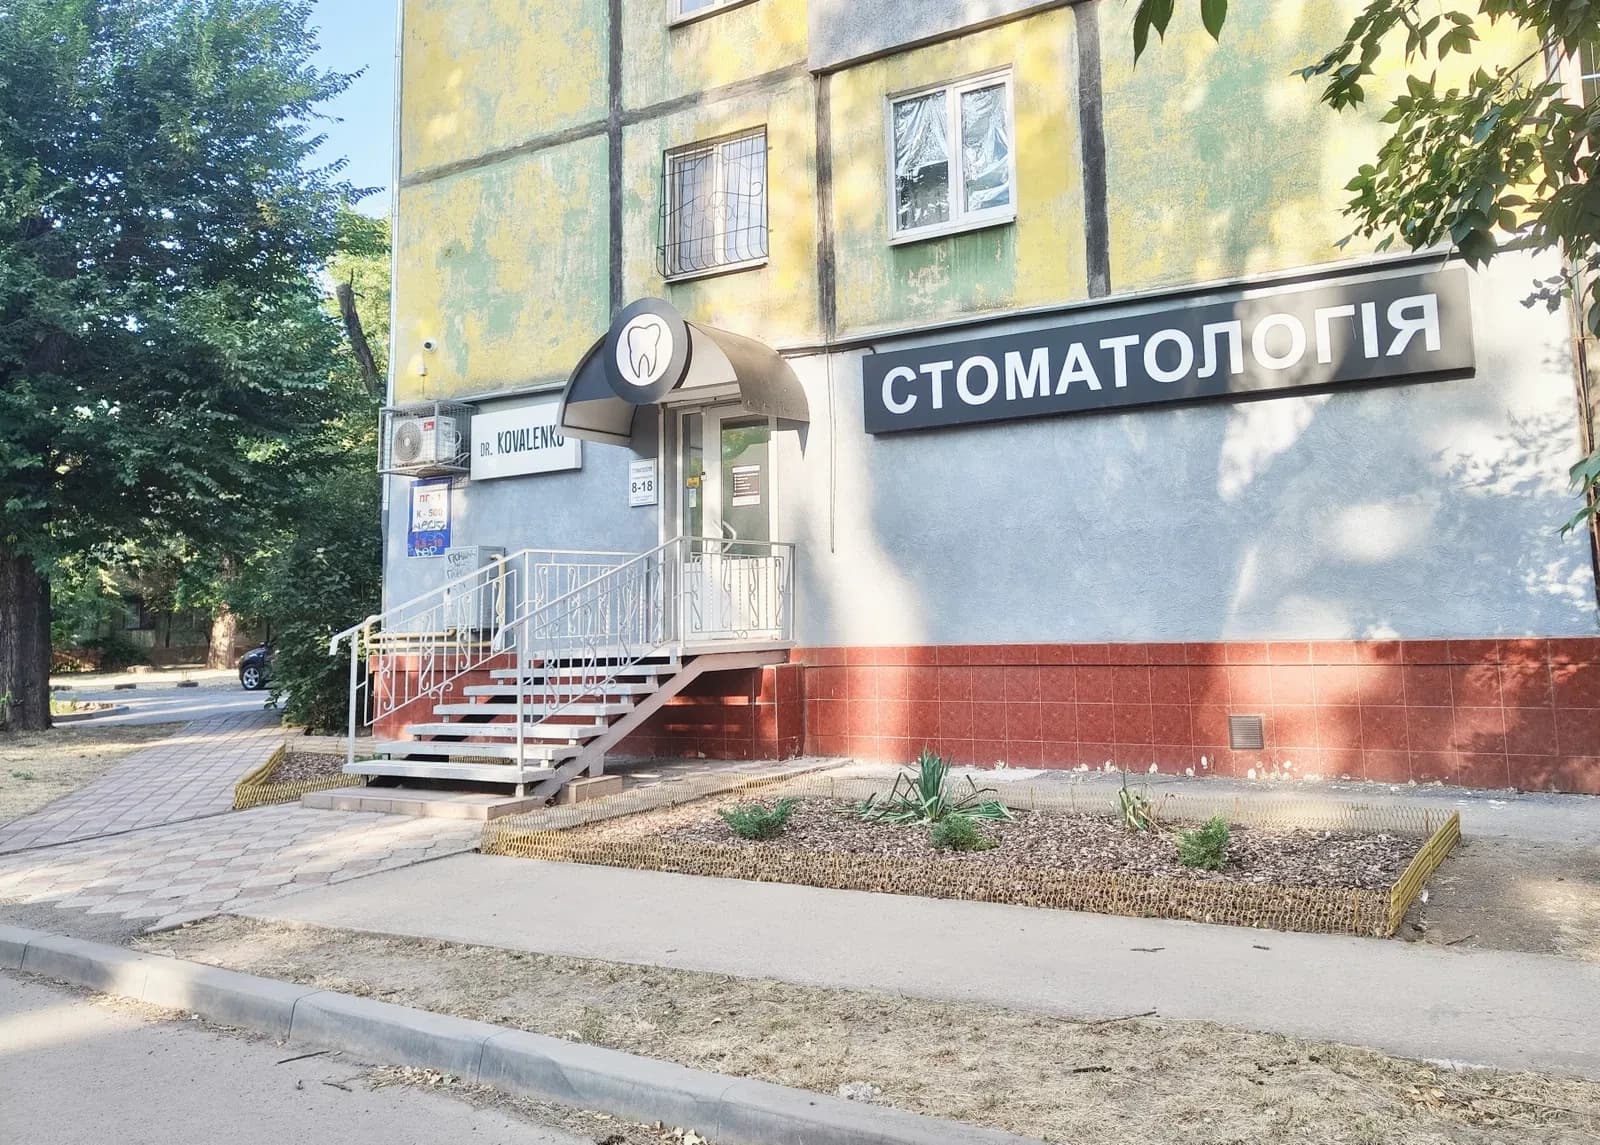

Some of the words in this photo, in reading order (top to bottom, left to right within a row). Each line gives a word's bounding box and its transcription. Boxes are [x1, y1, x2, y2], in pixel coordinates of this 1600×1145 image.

[881, 293, 1442, 414] СТОМАТОЛОГІЯ
[480, 442, 494, 457] DR.
[631, 480, 653, 493] 8-18
